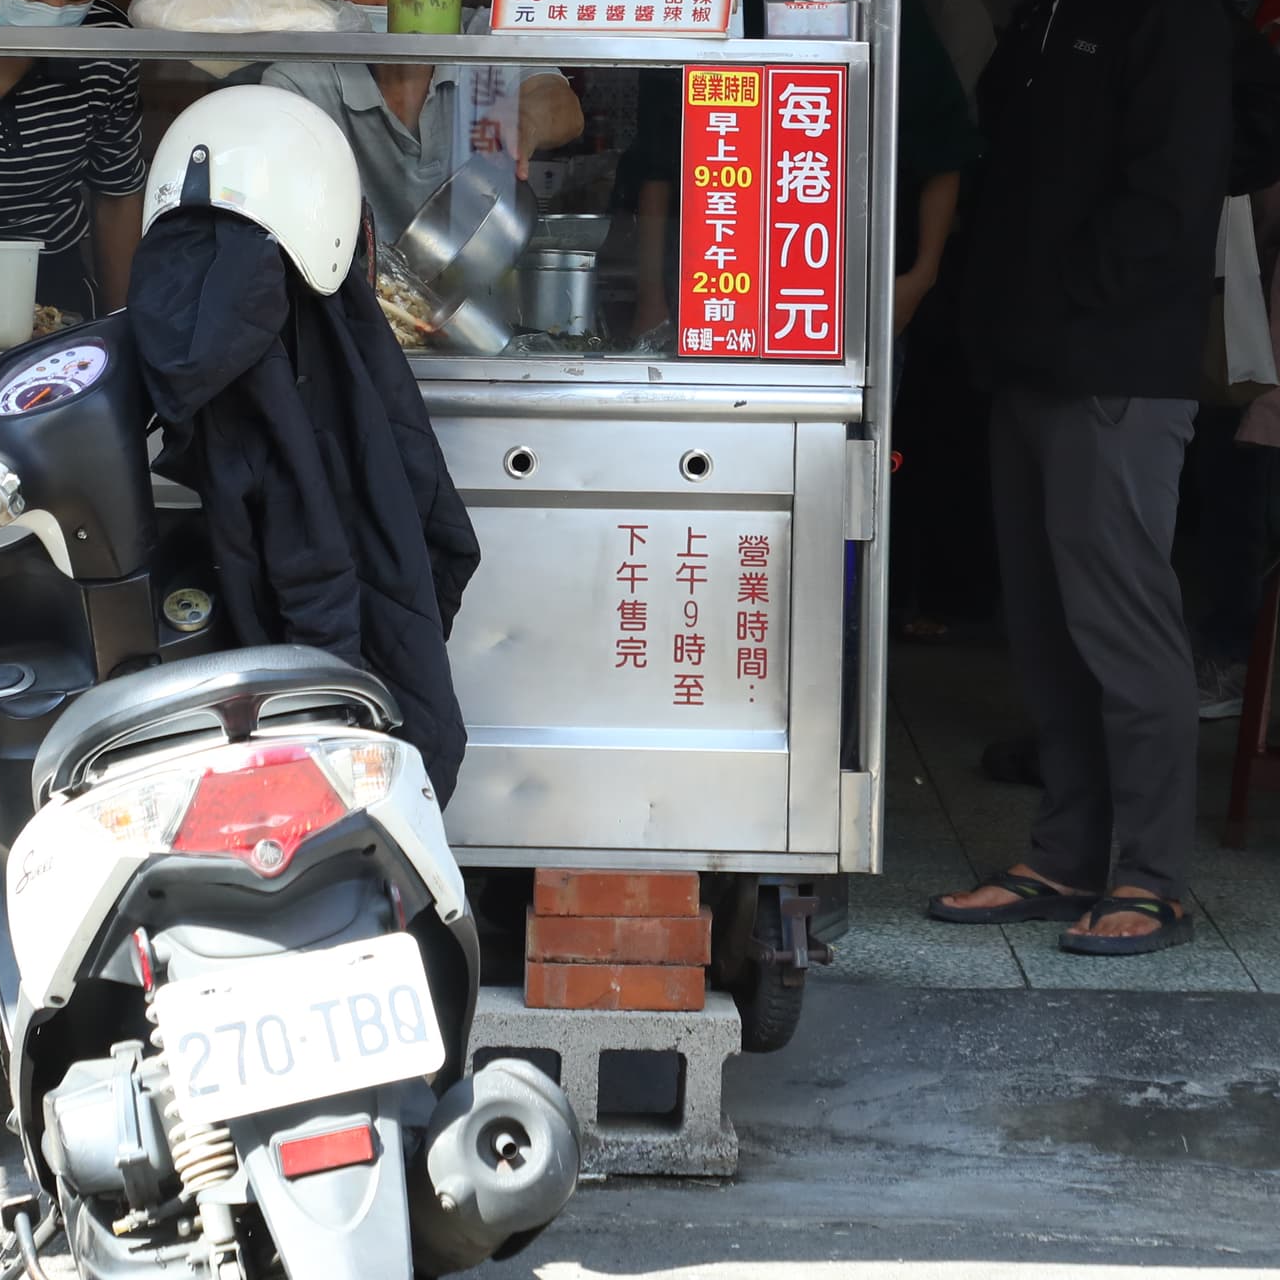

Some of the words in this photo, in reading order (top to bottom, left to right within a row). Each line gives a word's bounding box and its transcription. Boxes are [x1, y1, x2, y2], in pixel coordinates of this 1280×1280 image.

[691, 75, 756, 103] 營業時間
[1073, 38, 1097, 55] ZEISS
[774, 83, 832, 340] 每捲70元
[615, 524, 649, 669] 下午售完
[673, 526, 709, 706] 上午9時至
